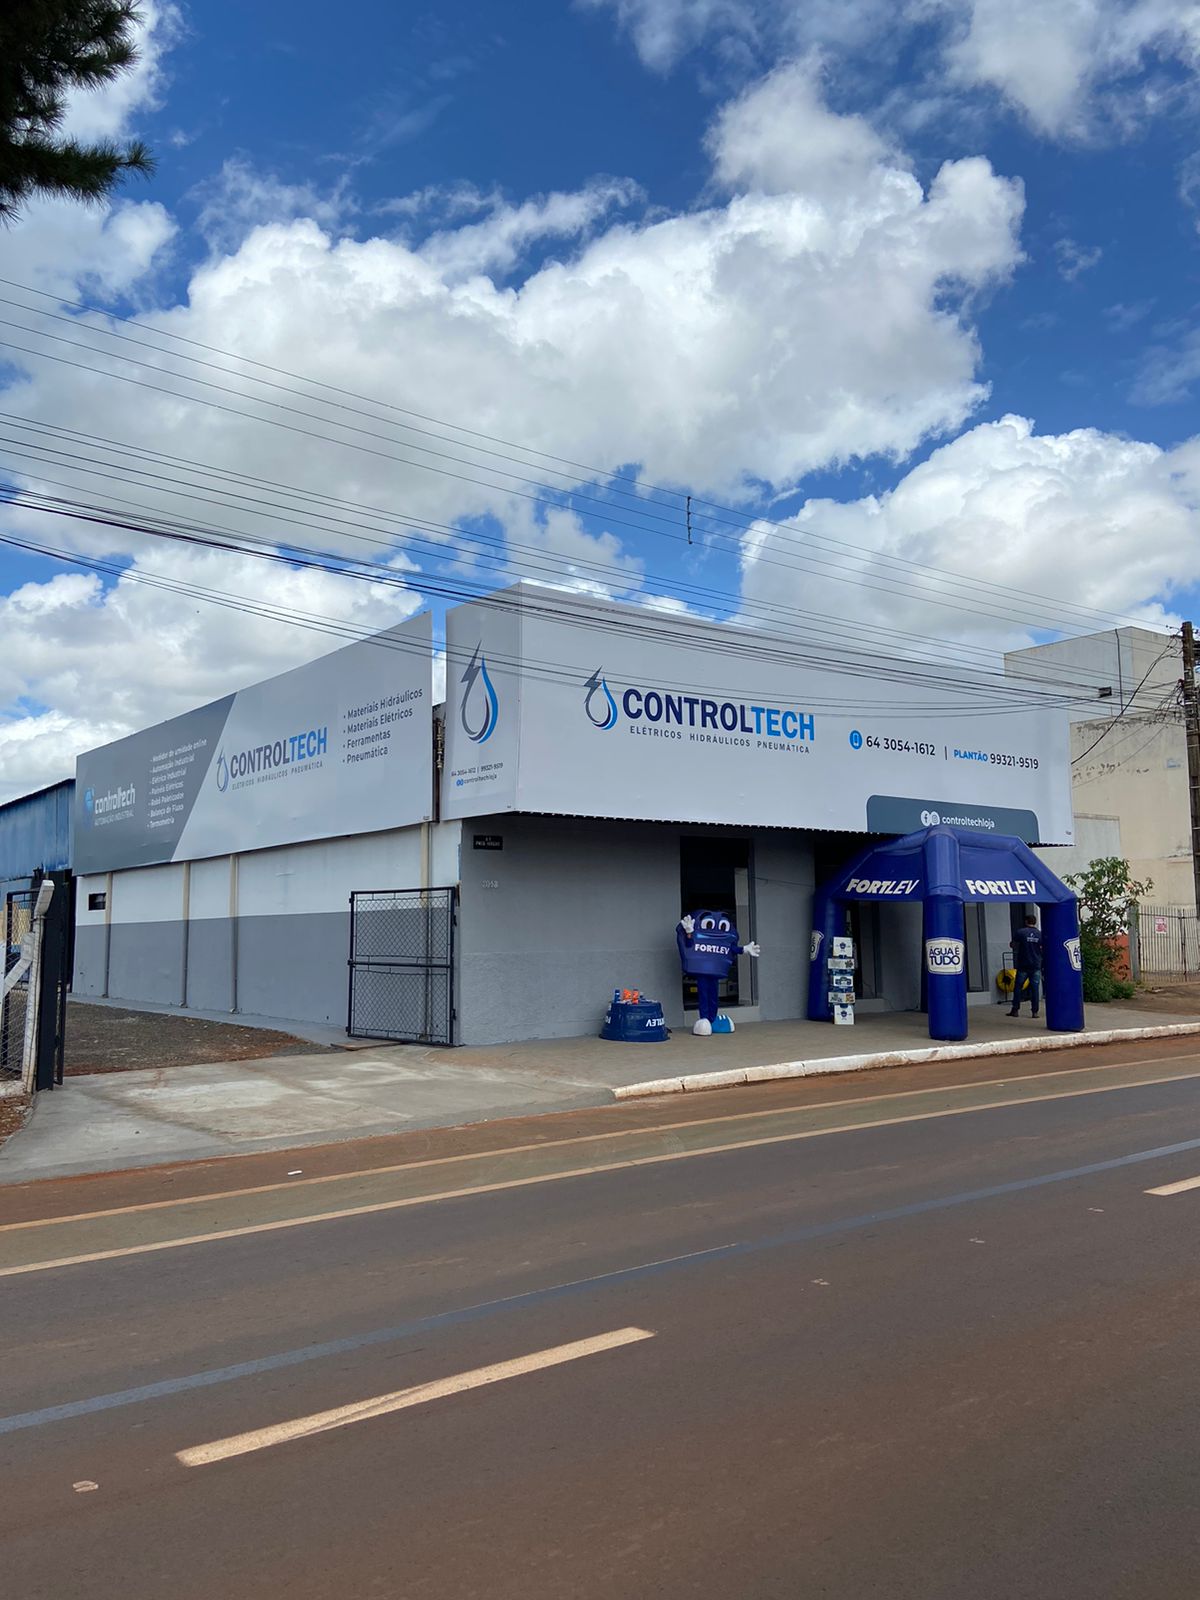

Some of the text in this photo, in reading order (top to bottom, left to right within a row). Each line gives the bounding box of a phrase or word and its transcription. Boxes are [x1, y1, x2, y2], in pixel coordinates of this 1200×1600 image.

[347, 688, 423, 720] Materiais Hidráulicos
[347, 708, 413, 734] Materiais Elétricos
[622, 688, 815, 741] CONTROLTECH
[347, 730, 391, 749] Ferramentas
[630, 725, 810, 754] ELÉTRICOS HIDRÁULICOS PNEUMÁTICA
[866, 735, 936, 756] 64 3054-1612
[230, 726, 328, 779] CONTROLTECH
[346, 746, 389, 764] Pneumática
[953, 748, 1039, 770] PLANTÃO 99321-9519
[95, 782, 136, 815] controltech
[942, 814, 995, 829] controltechloja
[845, 878, 920, 895] FORTLEV
[965, 879, 1037, 895] FORTLEV
[694, 943, 730, 955] FORTLEV
[929, 944, 960, 957] ÁGUA É
[929, 955, 961, 966] TUDO
